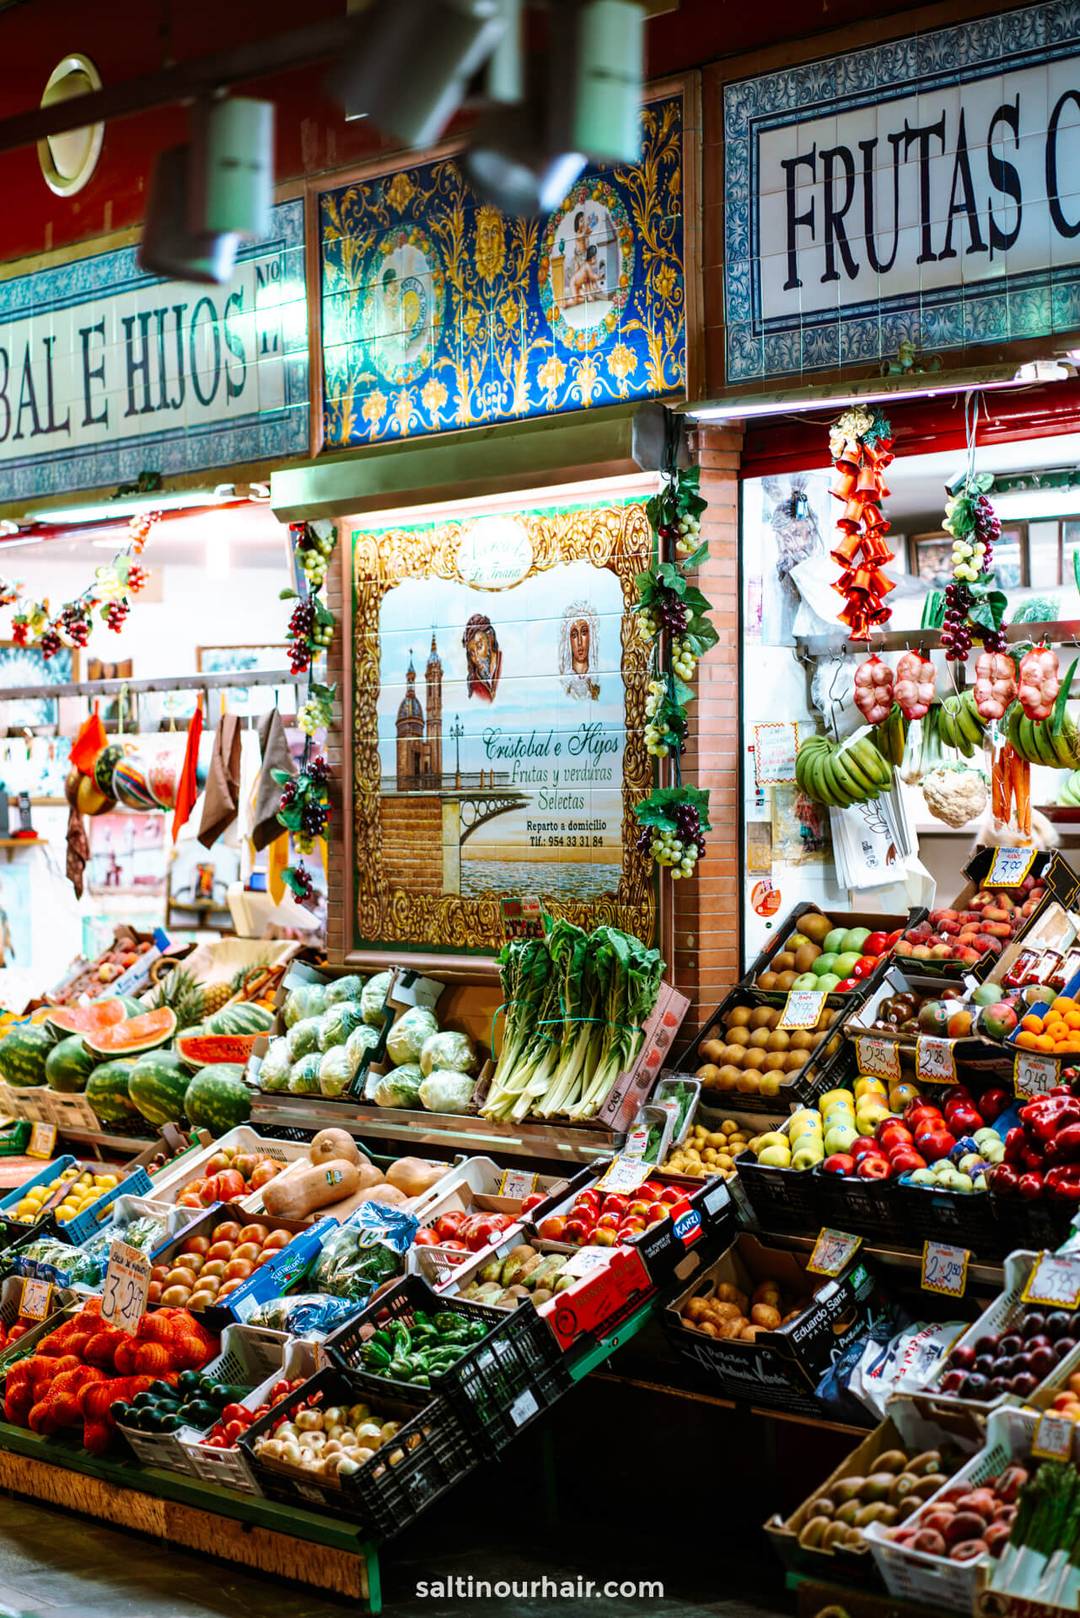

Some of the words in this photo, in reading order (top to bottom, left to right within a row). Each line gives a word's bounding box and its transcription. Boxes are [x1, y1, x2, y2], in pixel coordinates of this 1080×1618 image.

[781, 93, 1022, 291] FRUTAS
[79, 315, 108, 430] E
[122, 285, 247, 418] HIJOS
[482, 727, 553, 760] Cristobal
[554, 742, 562, 757] e
[568, 722, 619, 767] Hijos
[553, 769, 559, 787] y
[564, 760, 612, 783] verduras
[538, 786, 585, 811] Selectas
[527, 821, 558, 833] Reparto
[568, 819, 607, 831] domicilio
[548, 836, 564, 847] 954
[566, 836, 577, 847] 33
[580, 836, 589, 847] 31
[592, 836, 603, 847] 84
[607, 1090, 622, 1113] CASI
[675, 1212, 699, 1236] KANZI
[793, 1308, 828, 1343] Eduardo
[826, 1288, 848, 1311] Sanz
[808, 1307, 843, 1340] PATATAS
